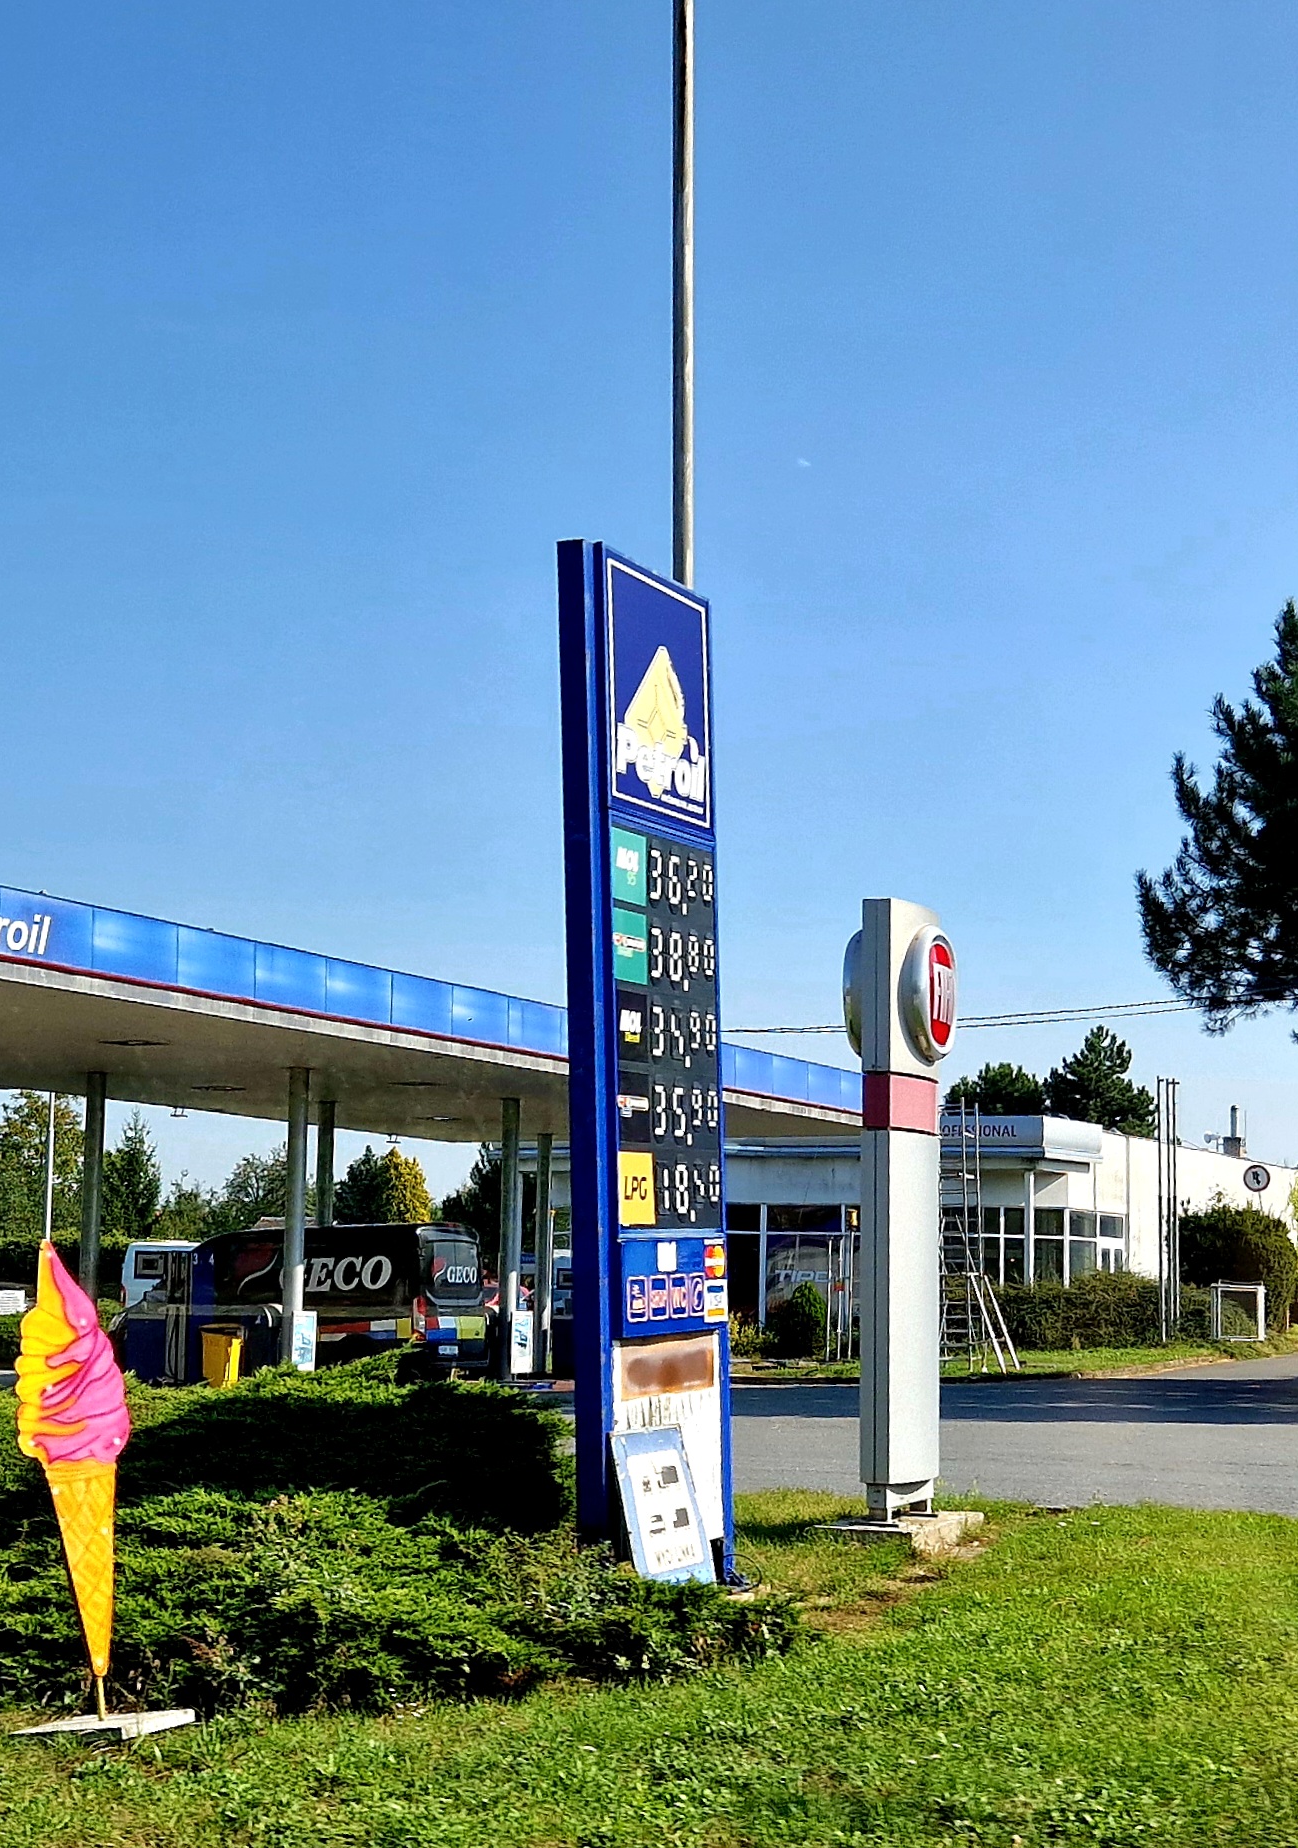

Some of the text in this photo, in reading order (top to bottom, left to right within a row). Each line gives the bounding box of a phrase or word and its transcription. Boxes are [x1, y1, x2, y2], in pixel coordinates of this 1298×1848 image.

[616, 722, 705, 803] Petroil
[624, 1176, 647, 1200] LPG
[192, 1252, 214, 1266] 3 4
[279, 1256, 392, 1292] ECO
[447, 1265, 477, 1283] GECO
